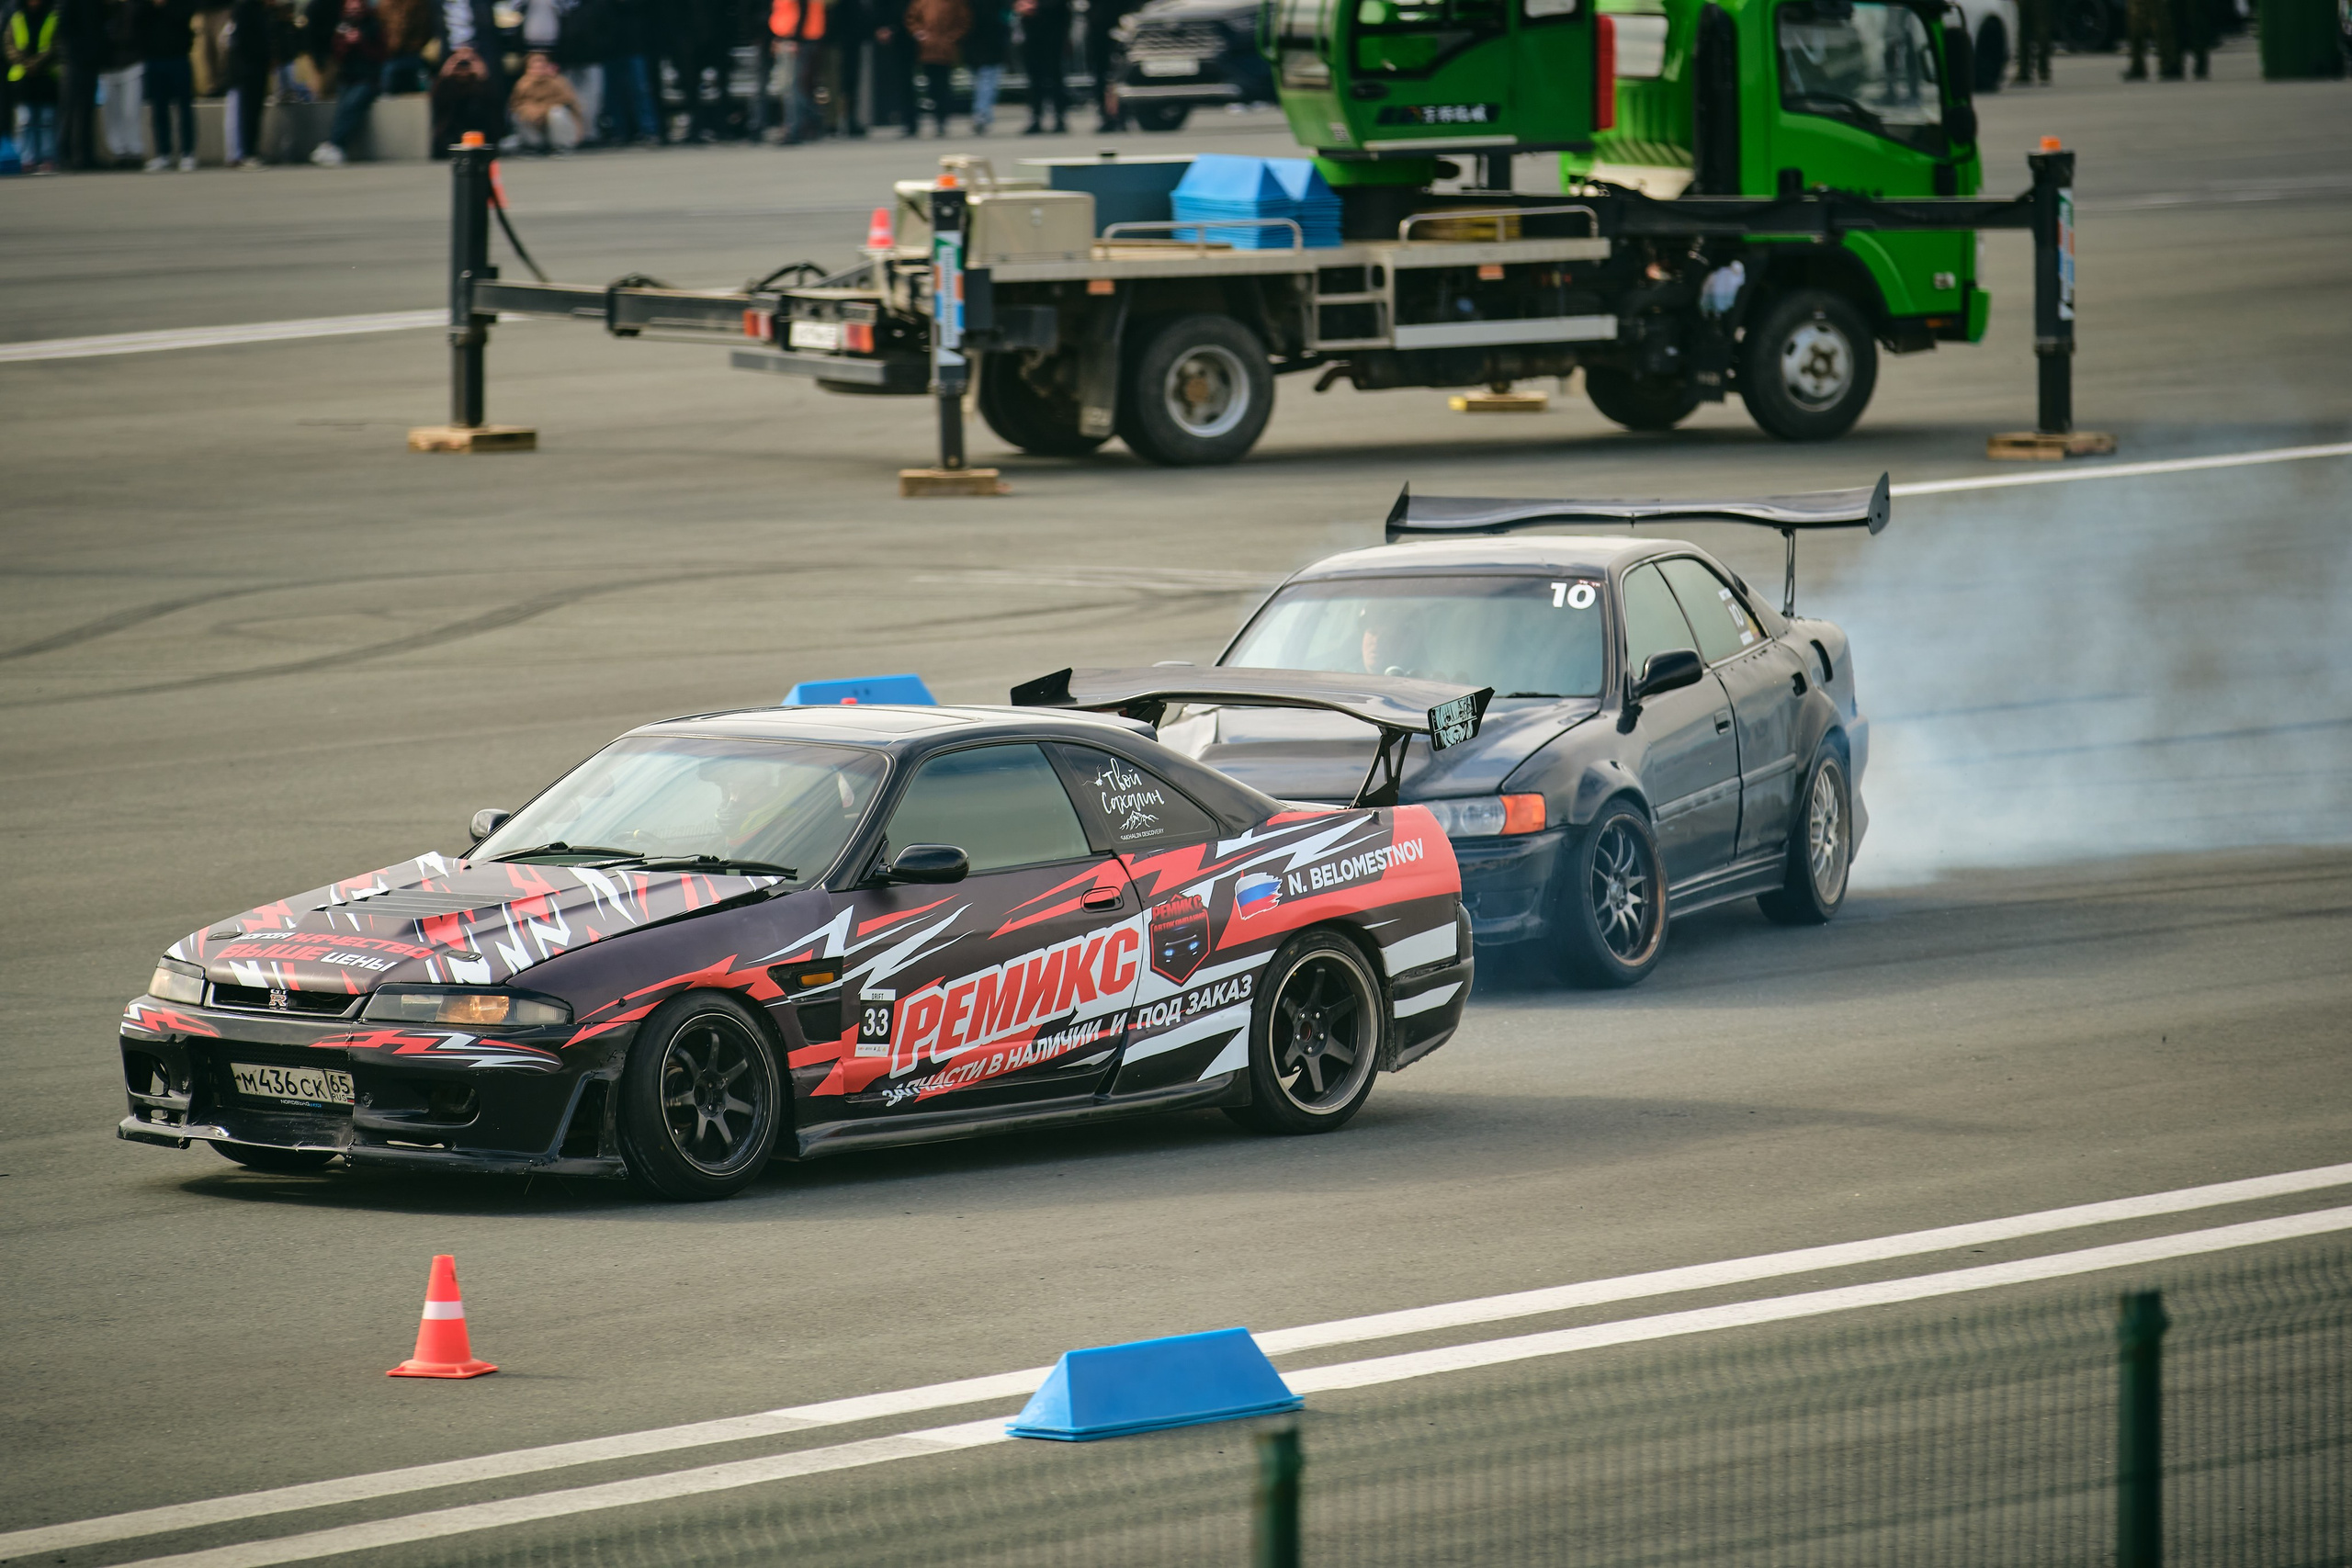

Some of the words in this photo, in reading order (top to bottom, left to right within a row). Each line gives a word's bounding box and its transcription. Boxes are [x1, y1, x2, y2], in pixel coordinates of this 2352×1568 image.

[1550, 581, 1597, 610] 10
[1102, 757, 1143, 792] Твой
[1101, 789, 1165, 815] Сахалин
[1120, 831, 1142, 840] SAKHALIN
[1141, 828, 1165, 838] DISCOVERY
[1287, 872, 1308, 897] N.
[1309, 837, 1424, 890] BELOMESTNOV
[1151, 894, 1204, 921] РЕМИКС
[213, 943, 334, 961] ВЫШЕ
[320, 951, 399, 972] ЦЕНЫ
[284, 932, 435, 960] КАЧЕСТВО
[893, 924, 1141, 1075] РЕМИКС
[863, 1008, 889, 1037] 33
[881, 1056, 988, 1108] ЗАПЧАСТИ
[986, 1053, 1003, 1075] В
[1006, 1019, 1103, 1069] НАЛИЧИИ
[1109, 1011, 1128, 1037] И
[1136, 997, 1183, 1031] ПОД
[1184, 974, 1253, 1016] ЗАКАЗ
[329, 1074, 350, 1094] 65
[331, 1092, 347, 1102] RUS
